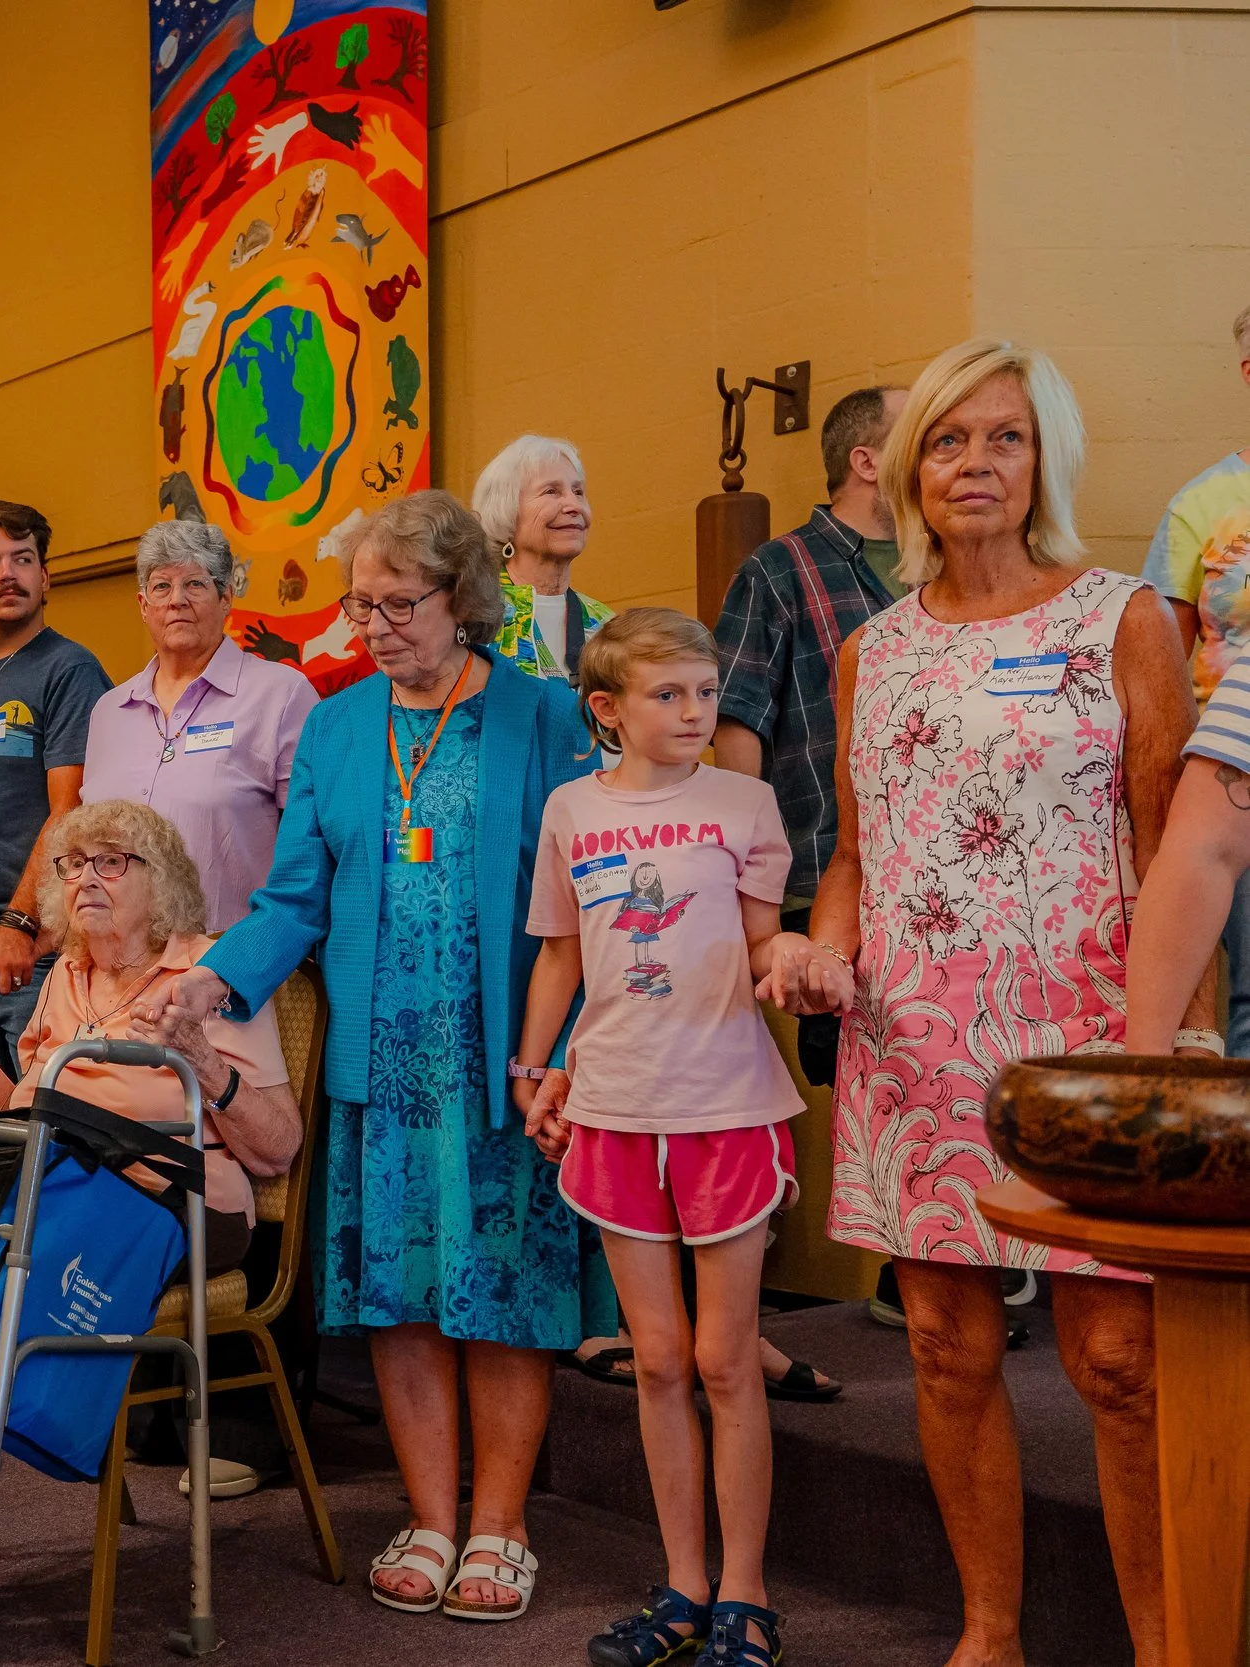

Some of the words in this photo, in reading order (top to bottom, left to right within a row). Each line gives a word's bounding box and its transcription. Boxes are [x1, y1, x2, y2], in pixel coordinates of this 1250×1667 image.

[1018, 657, 1041, 665] Hello
[571, 823, 724, 861] BOOKWORM
[586, 860, 604, 870] Hello
[597, 869, 628, 880] Conway
